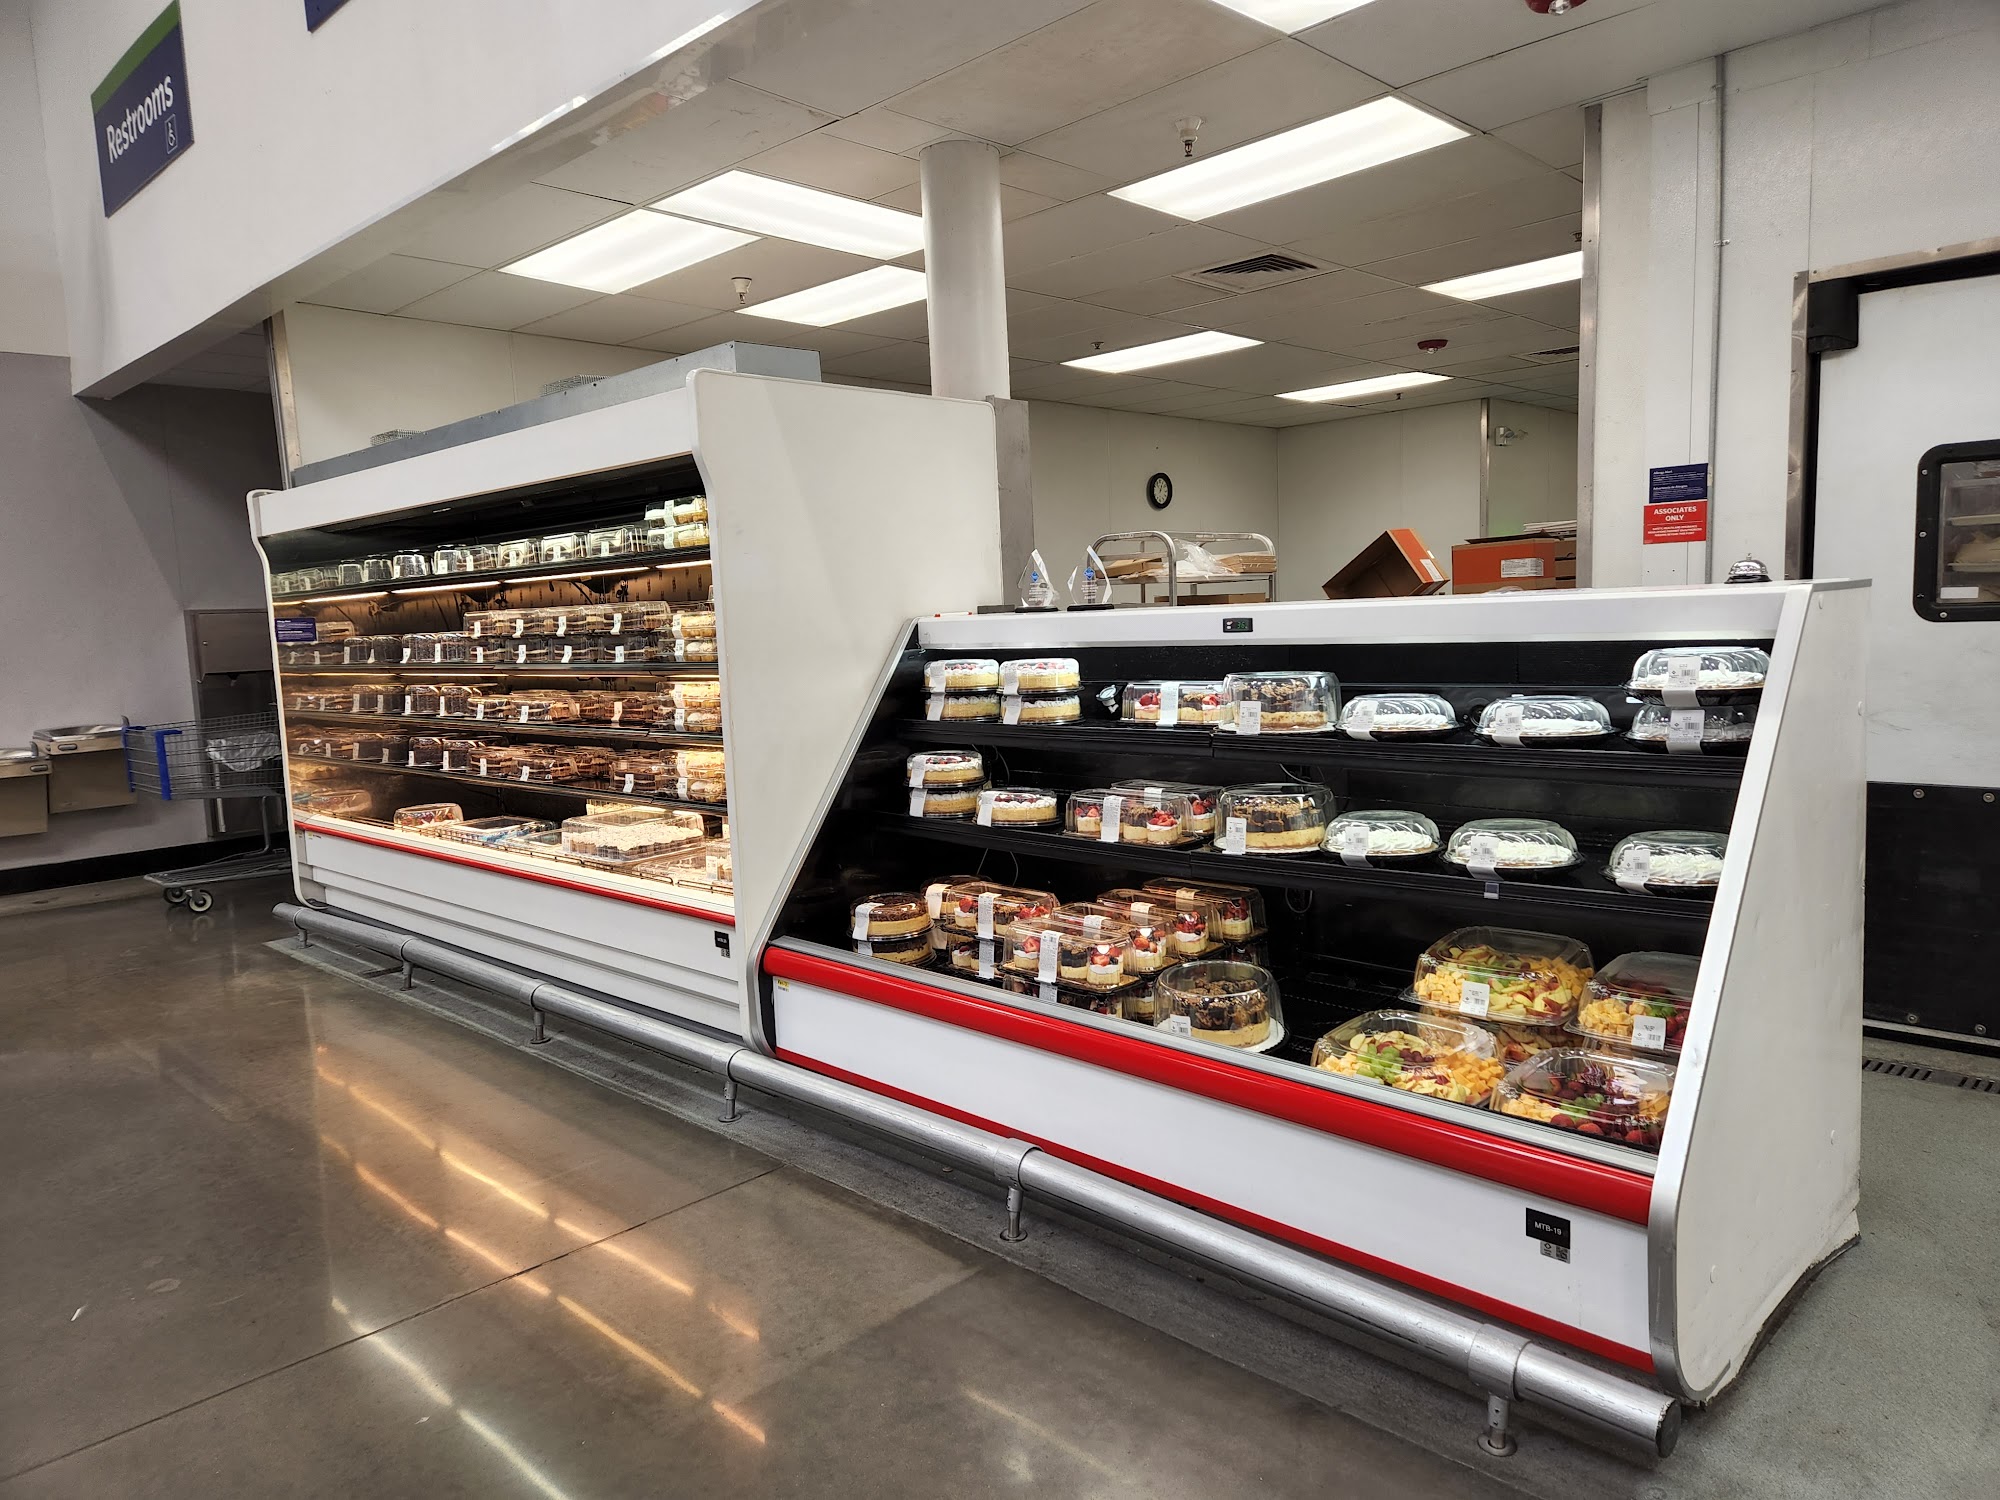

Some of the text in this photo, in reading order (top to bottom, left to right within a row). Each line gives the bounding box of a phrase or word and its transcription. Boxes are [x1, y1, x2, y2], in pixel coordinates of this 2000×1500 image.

[106, 75, 174, 164] Restrooms
[1654, 506, 1697, 515] ASSOCIATES
[1534, 1220, 1562, 1236] MTB-19
